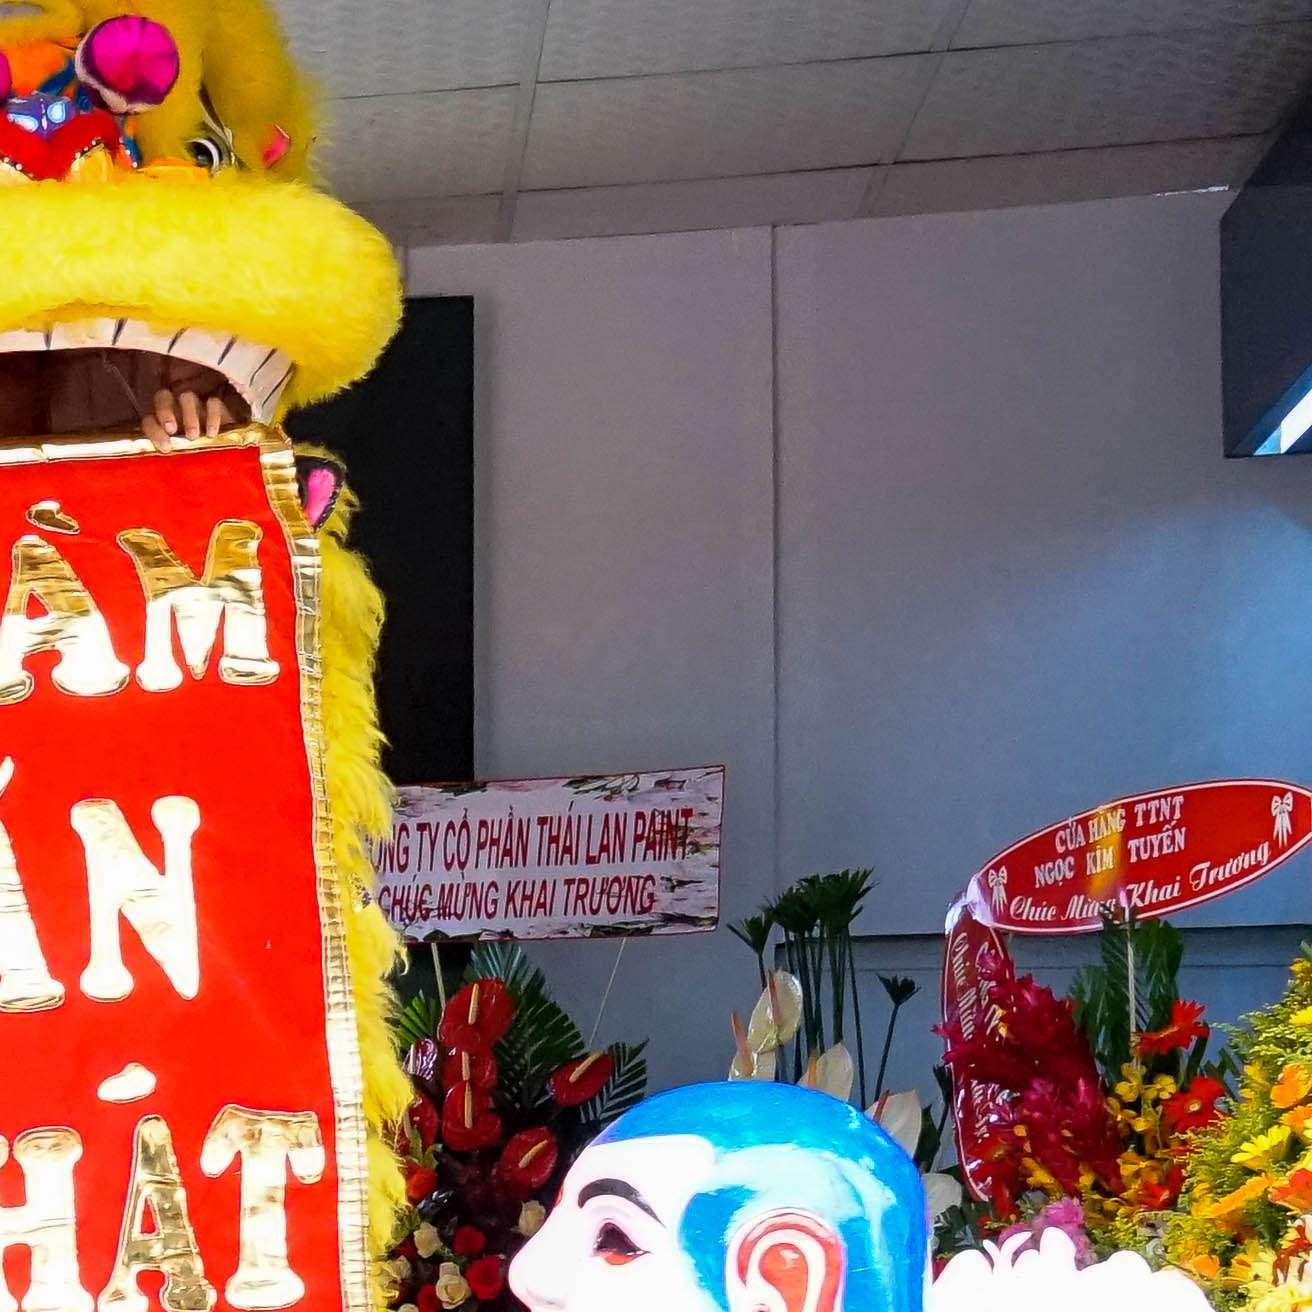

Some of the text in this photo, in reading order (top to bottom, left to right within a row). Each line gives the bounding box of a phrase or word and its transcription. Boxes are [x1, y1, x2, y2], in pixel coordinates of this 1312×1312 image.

[416, 821, 440, 872] TY
[443, 808, 471, 871] CỔ
[475, 805, 531, 869] PHẦN
[537, 800, 581, 867] THÁI
[585, 812, 627, 865] LAN
[631, 808, 693, 862] PAINT
[1134, 795, 1184, 827] TTNT
[1034, 856, 1075, 889] NGỌC
[1128, 820, 1187, 863] TUYẾN
[1126, 876, 1182, 907] Khai
[1190, 841, 1272, 892] Trương
[378, 872, 656, 922] CHÚC MỪNG KHAI TRƯƠNG
